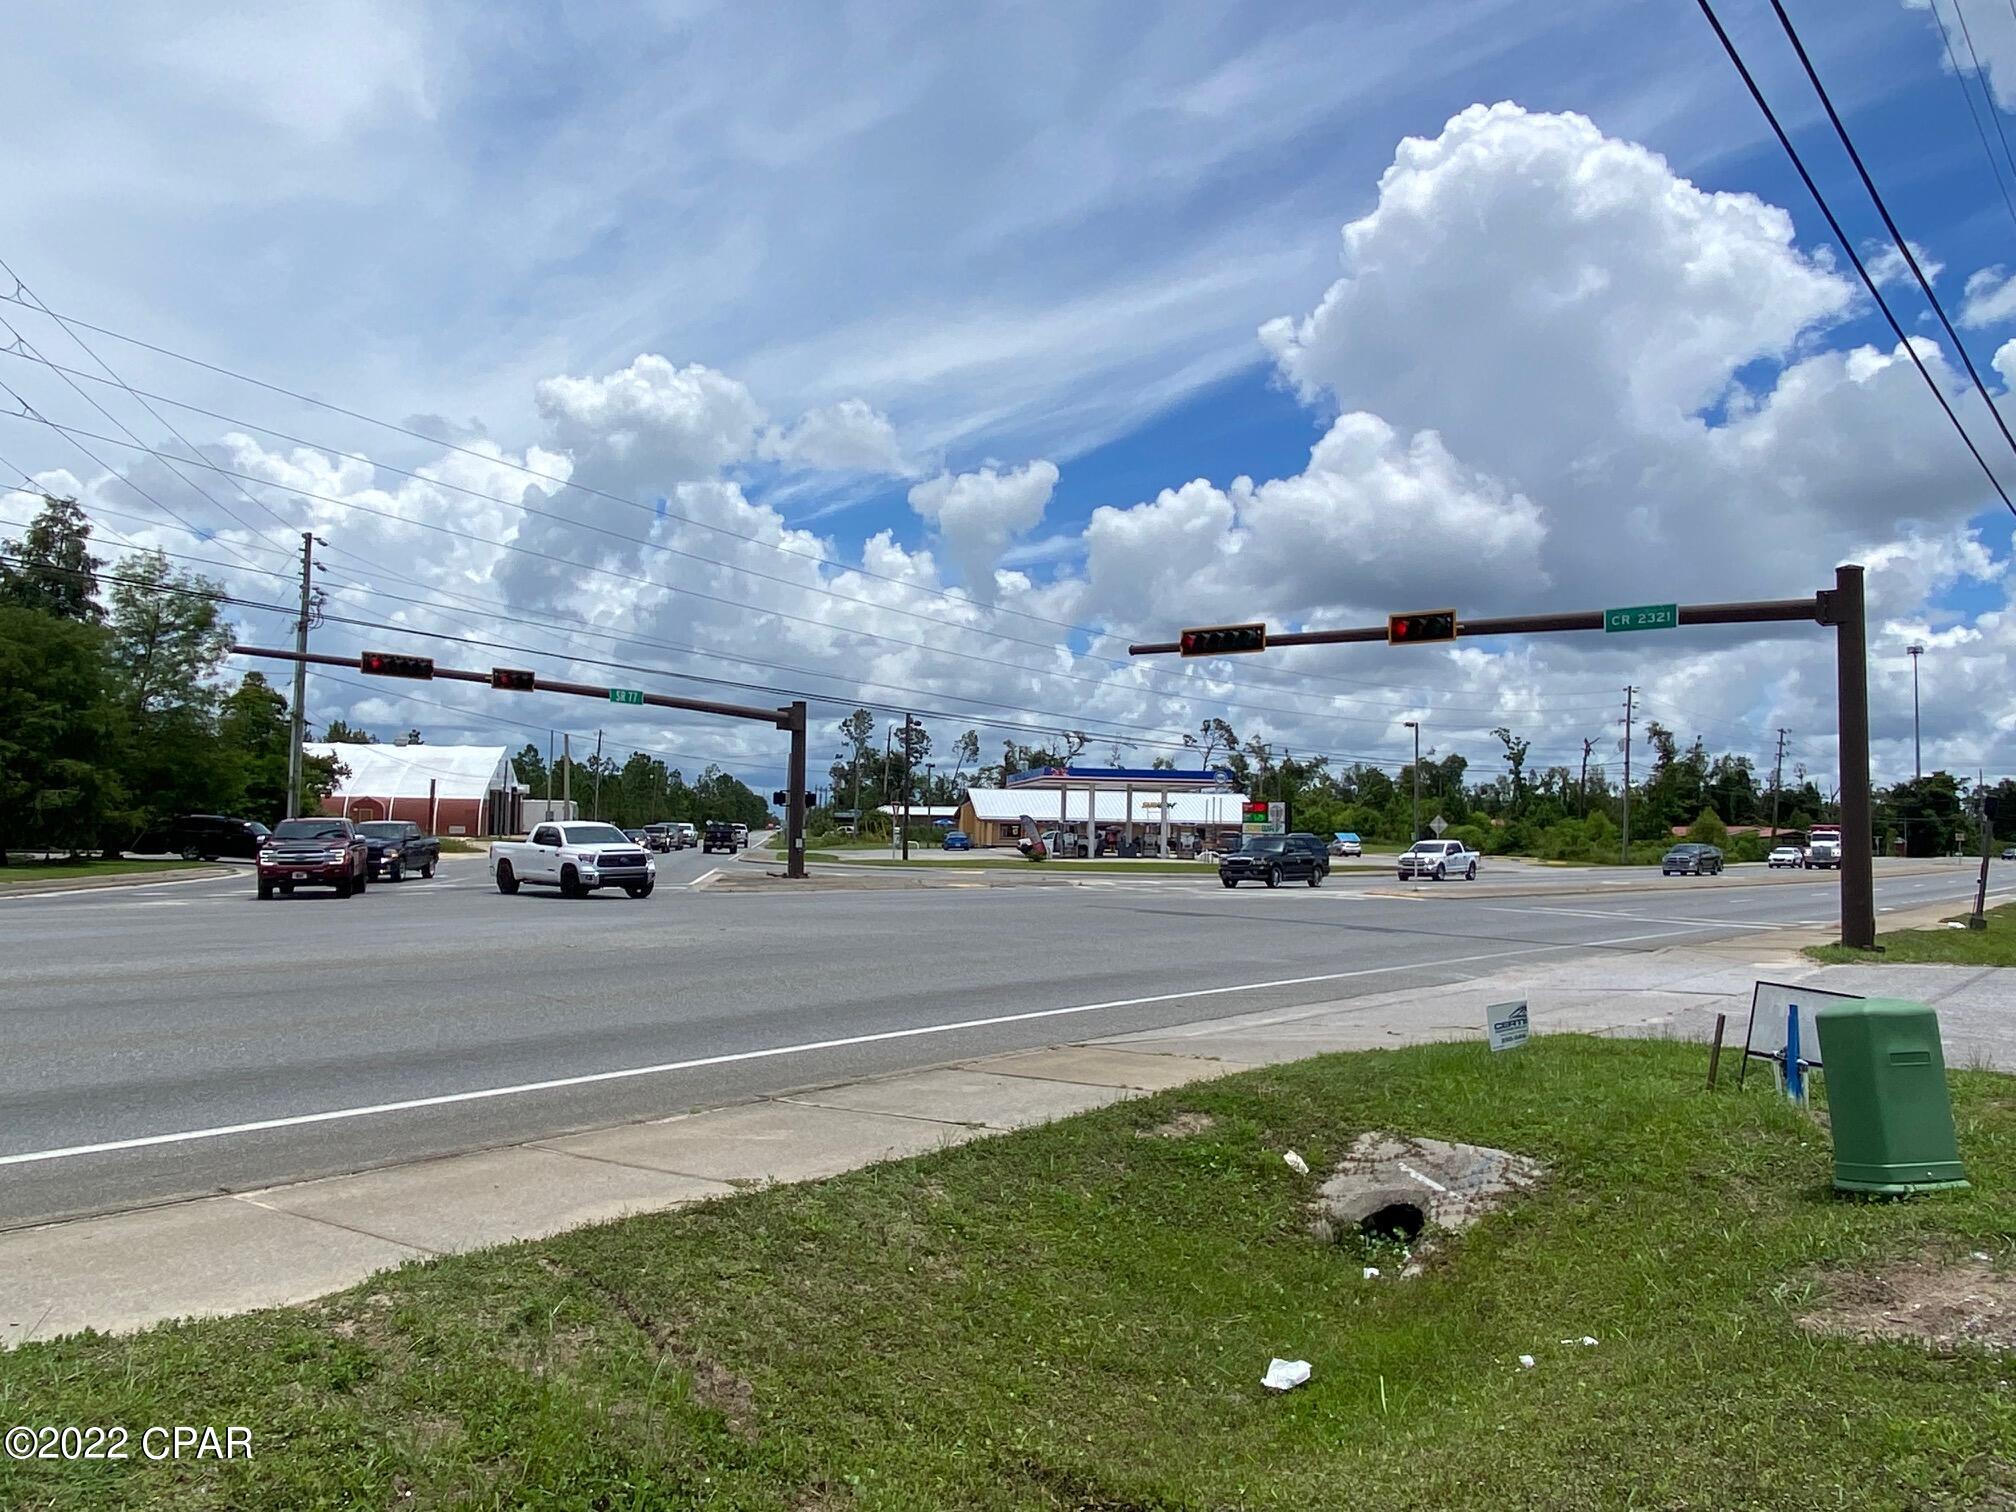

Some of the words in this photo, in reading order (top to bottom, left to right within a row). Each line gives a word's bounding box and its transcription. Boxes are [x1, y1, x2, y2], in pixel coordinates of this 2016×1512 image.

[1611, 614, 1630, 626] CR
[1637, 611, 1671, 624] 2321
[615, 690, 626, 702] SR
[628, 691, 638, 703] 77
